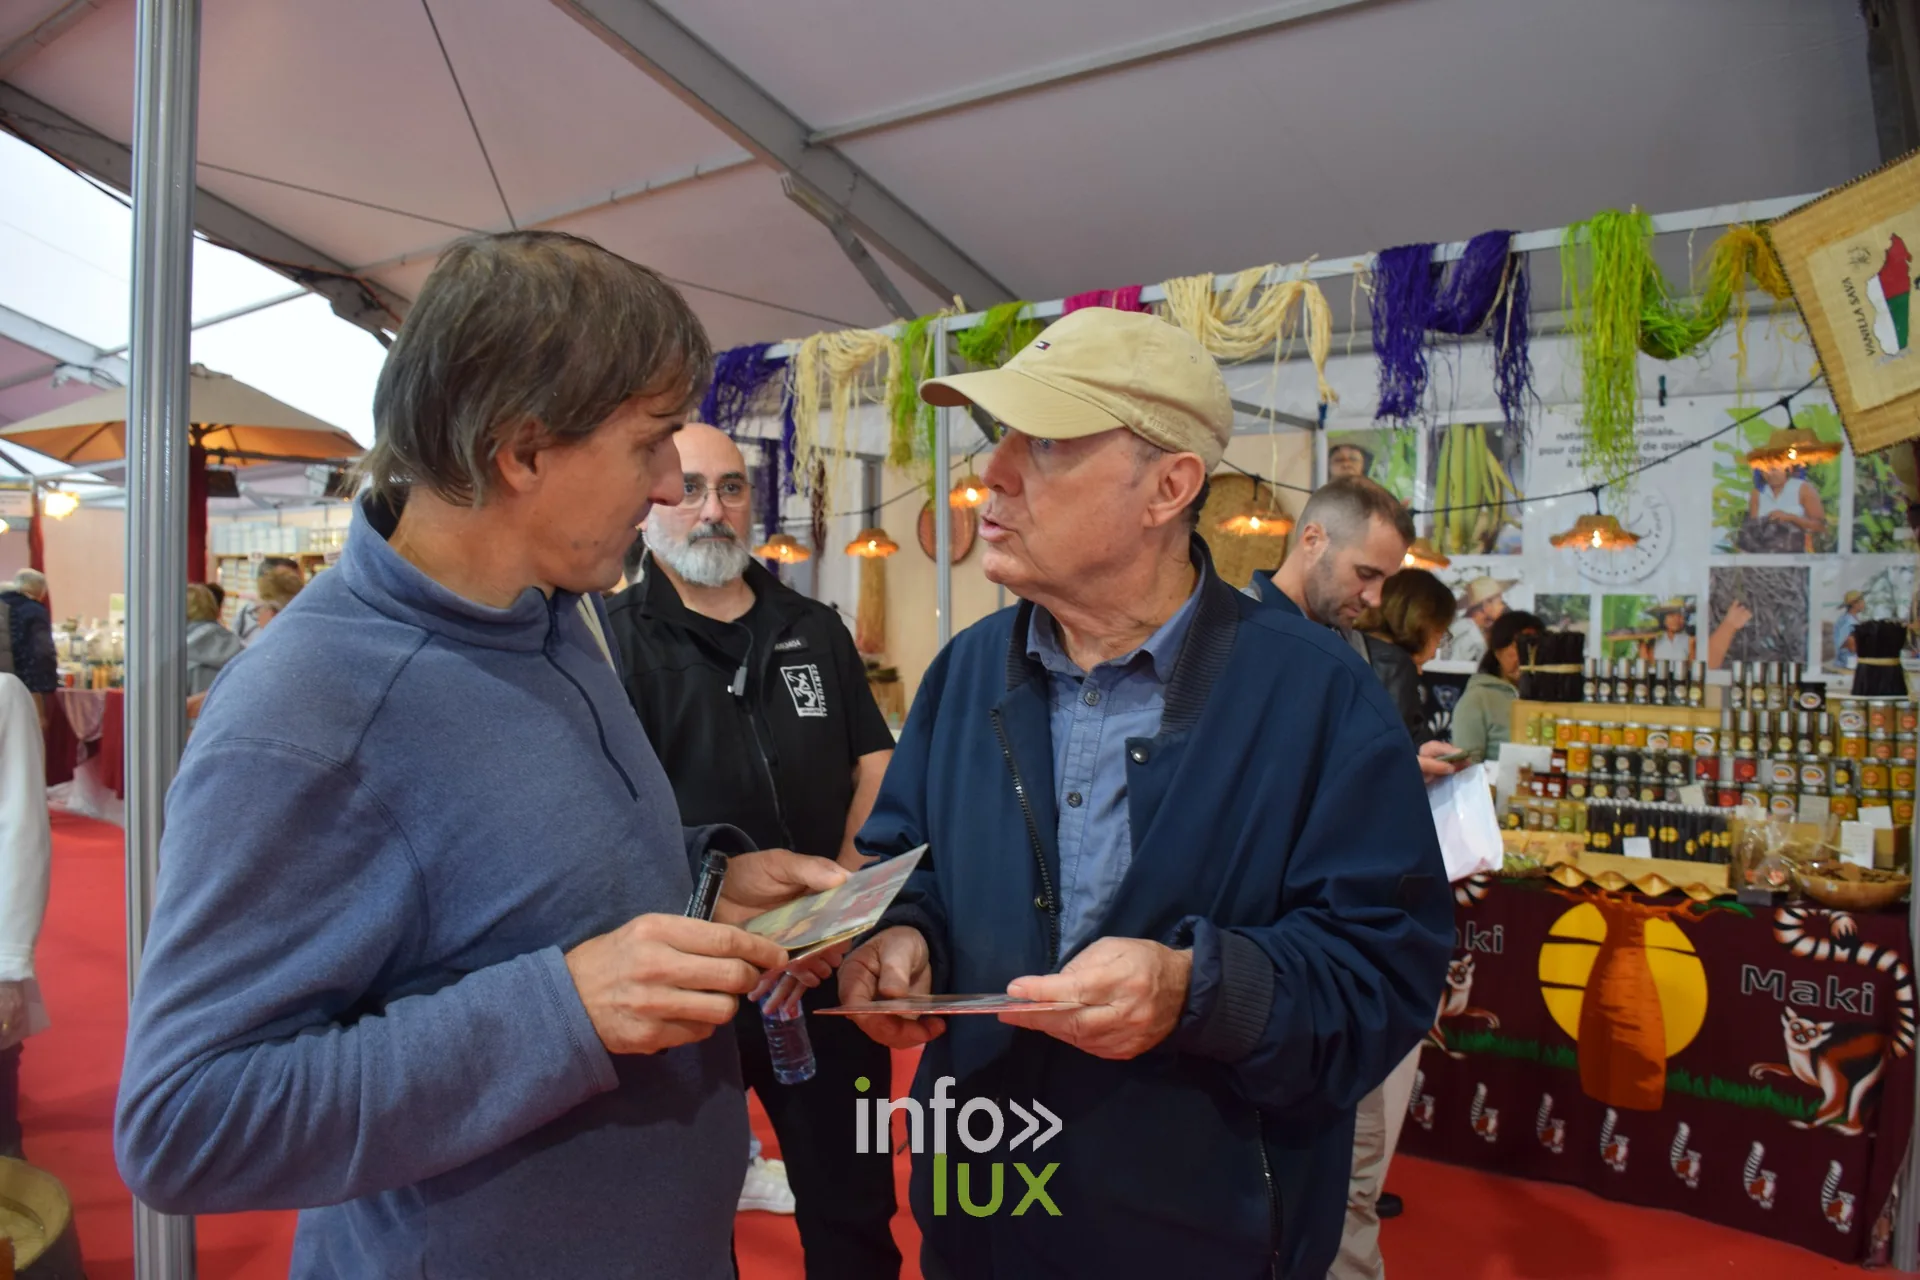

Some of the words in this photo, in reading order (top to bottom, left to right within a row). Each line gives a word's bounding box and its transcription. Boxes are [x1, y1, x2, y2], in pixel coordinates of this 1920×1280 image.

[1842, 276, 1861, 306] SAVA
[1853, 308, 1876, 356] VANILLA
[1642, 441, 1657, 451] de
[1455, 920, 1504, 954] ki
[1741, 963, 1876, 1016] Maki
